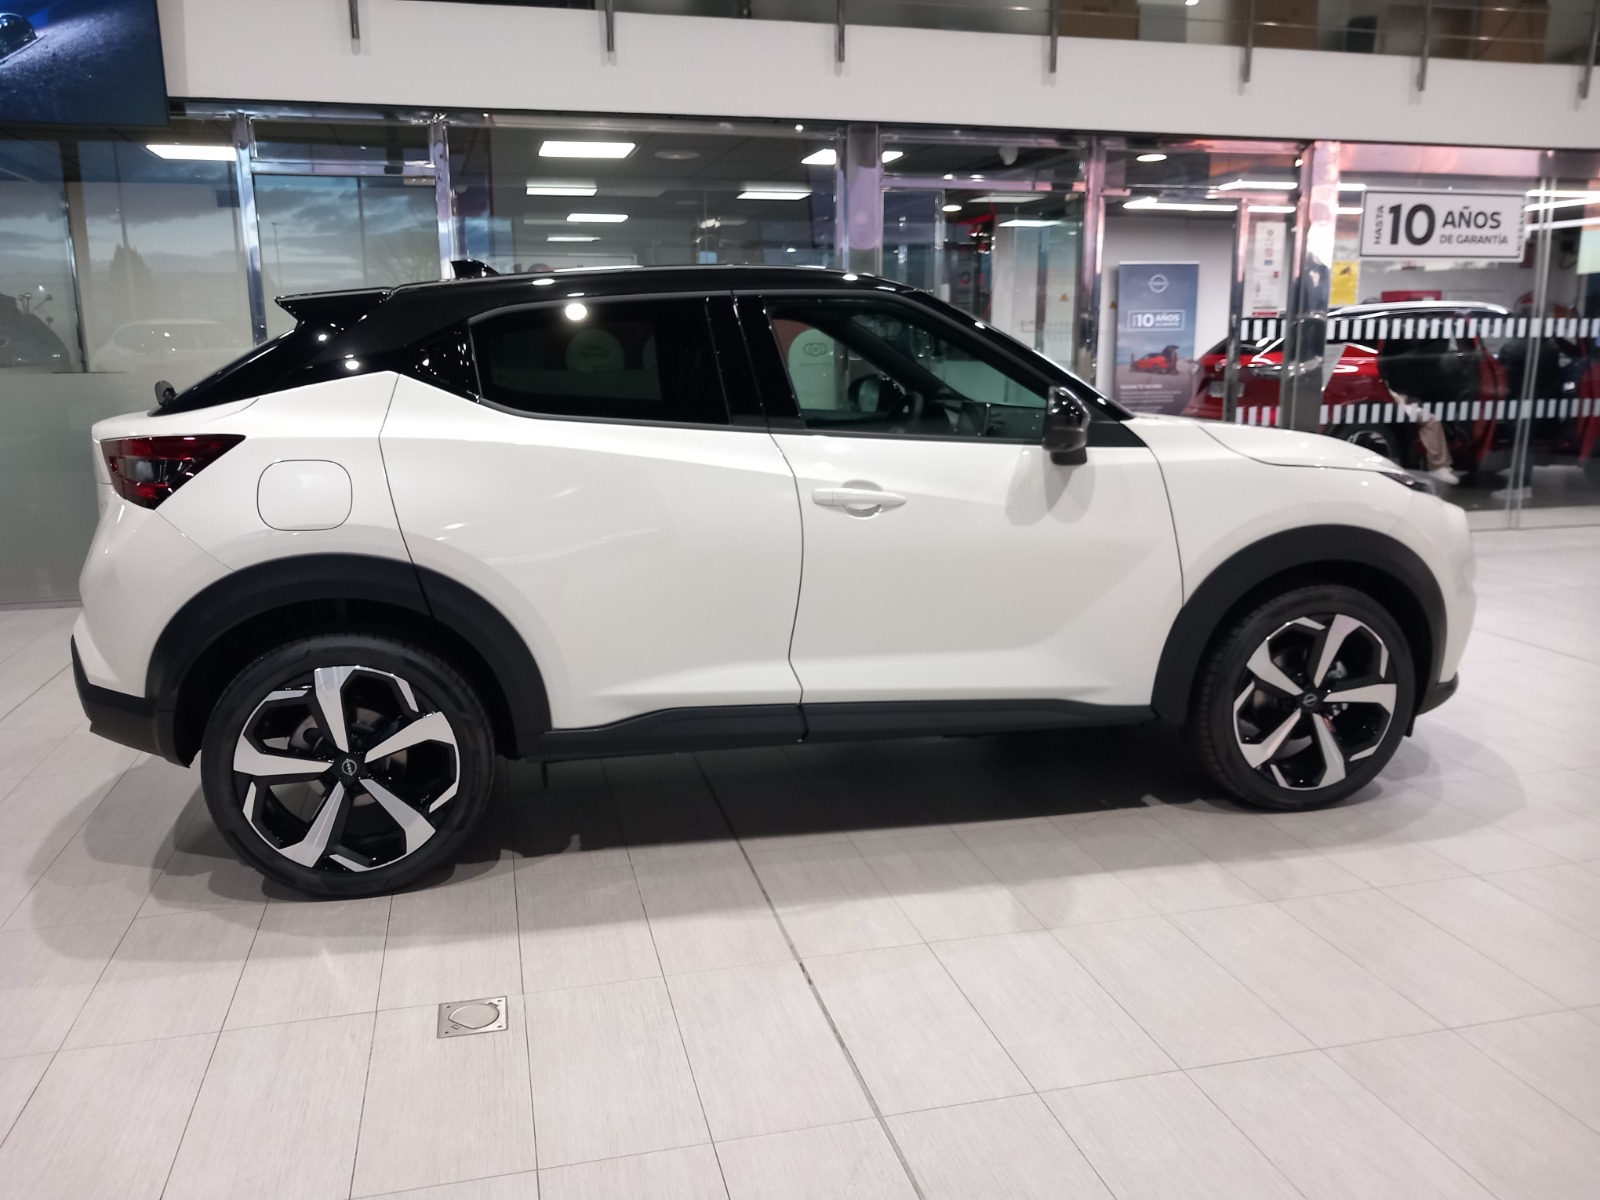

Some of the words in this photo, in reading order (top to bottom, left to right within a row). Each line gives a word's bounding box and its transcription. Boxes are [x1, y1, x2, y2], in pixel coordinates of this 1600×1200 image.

[1374, 205, 1385, 245] HASTA
[1388, 203, 1436, 246] 10
[1442, 206, 1501, 229] AÑOS
[1439, 234, 1454, 244] DE
[1456, 233, 1508, 245] GARANTÍA
[1137, 313, 1154, 328] 10
